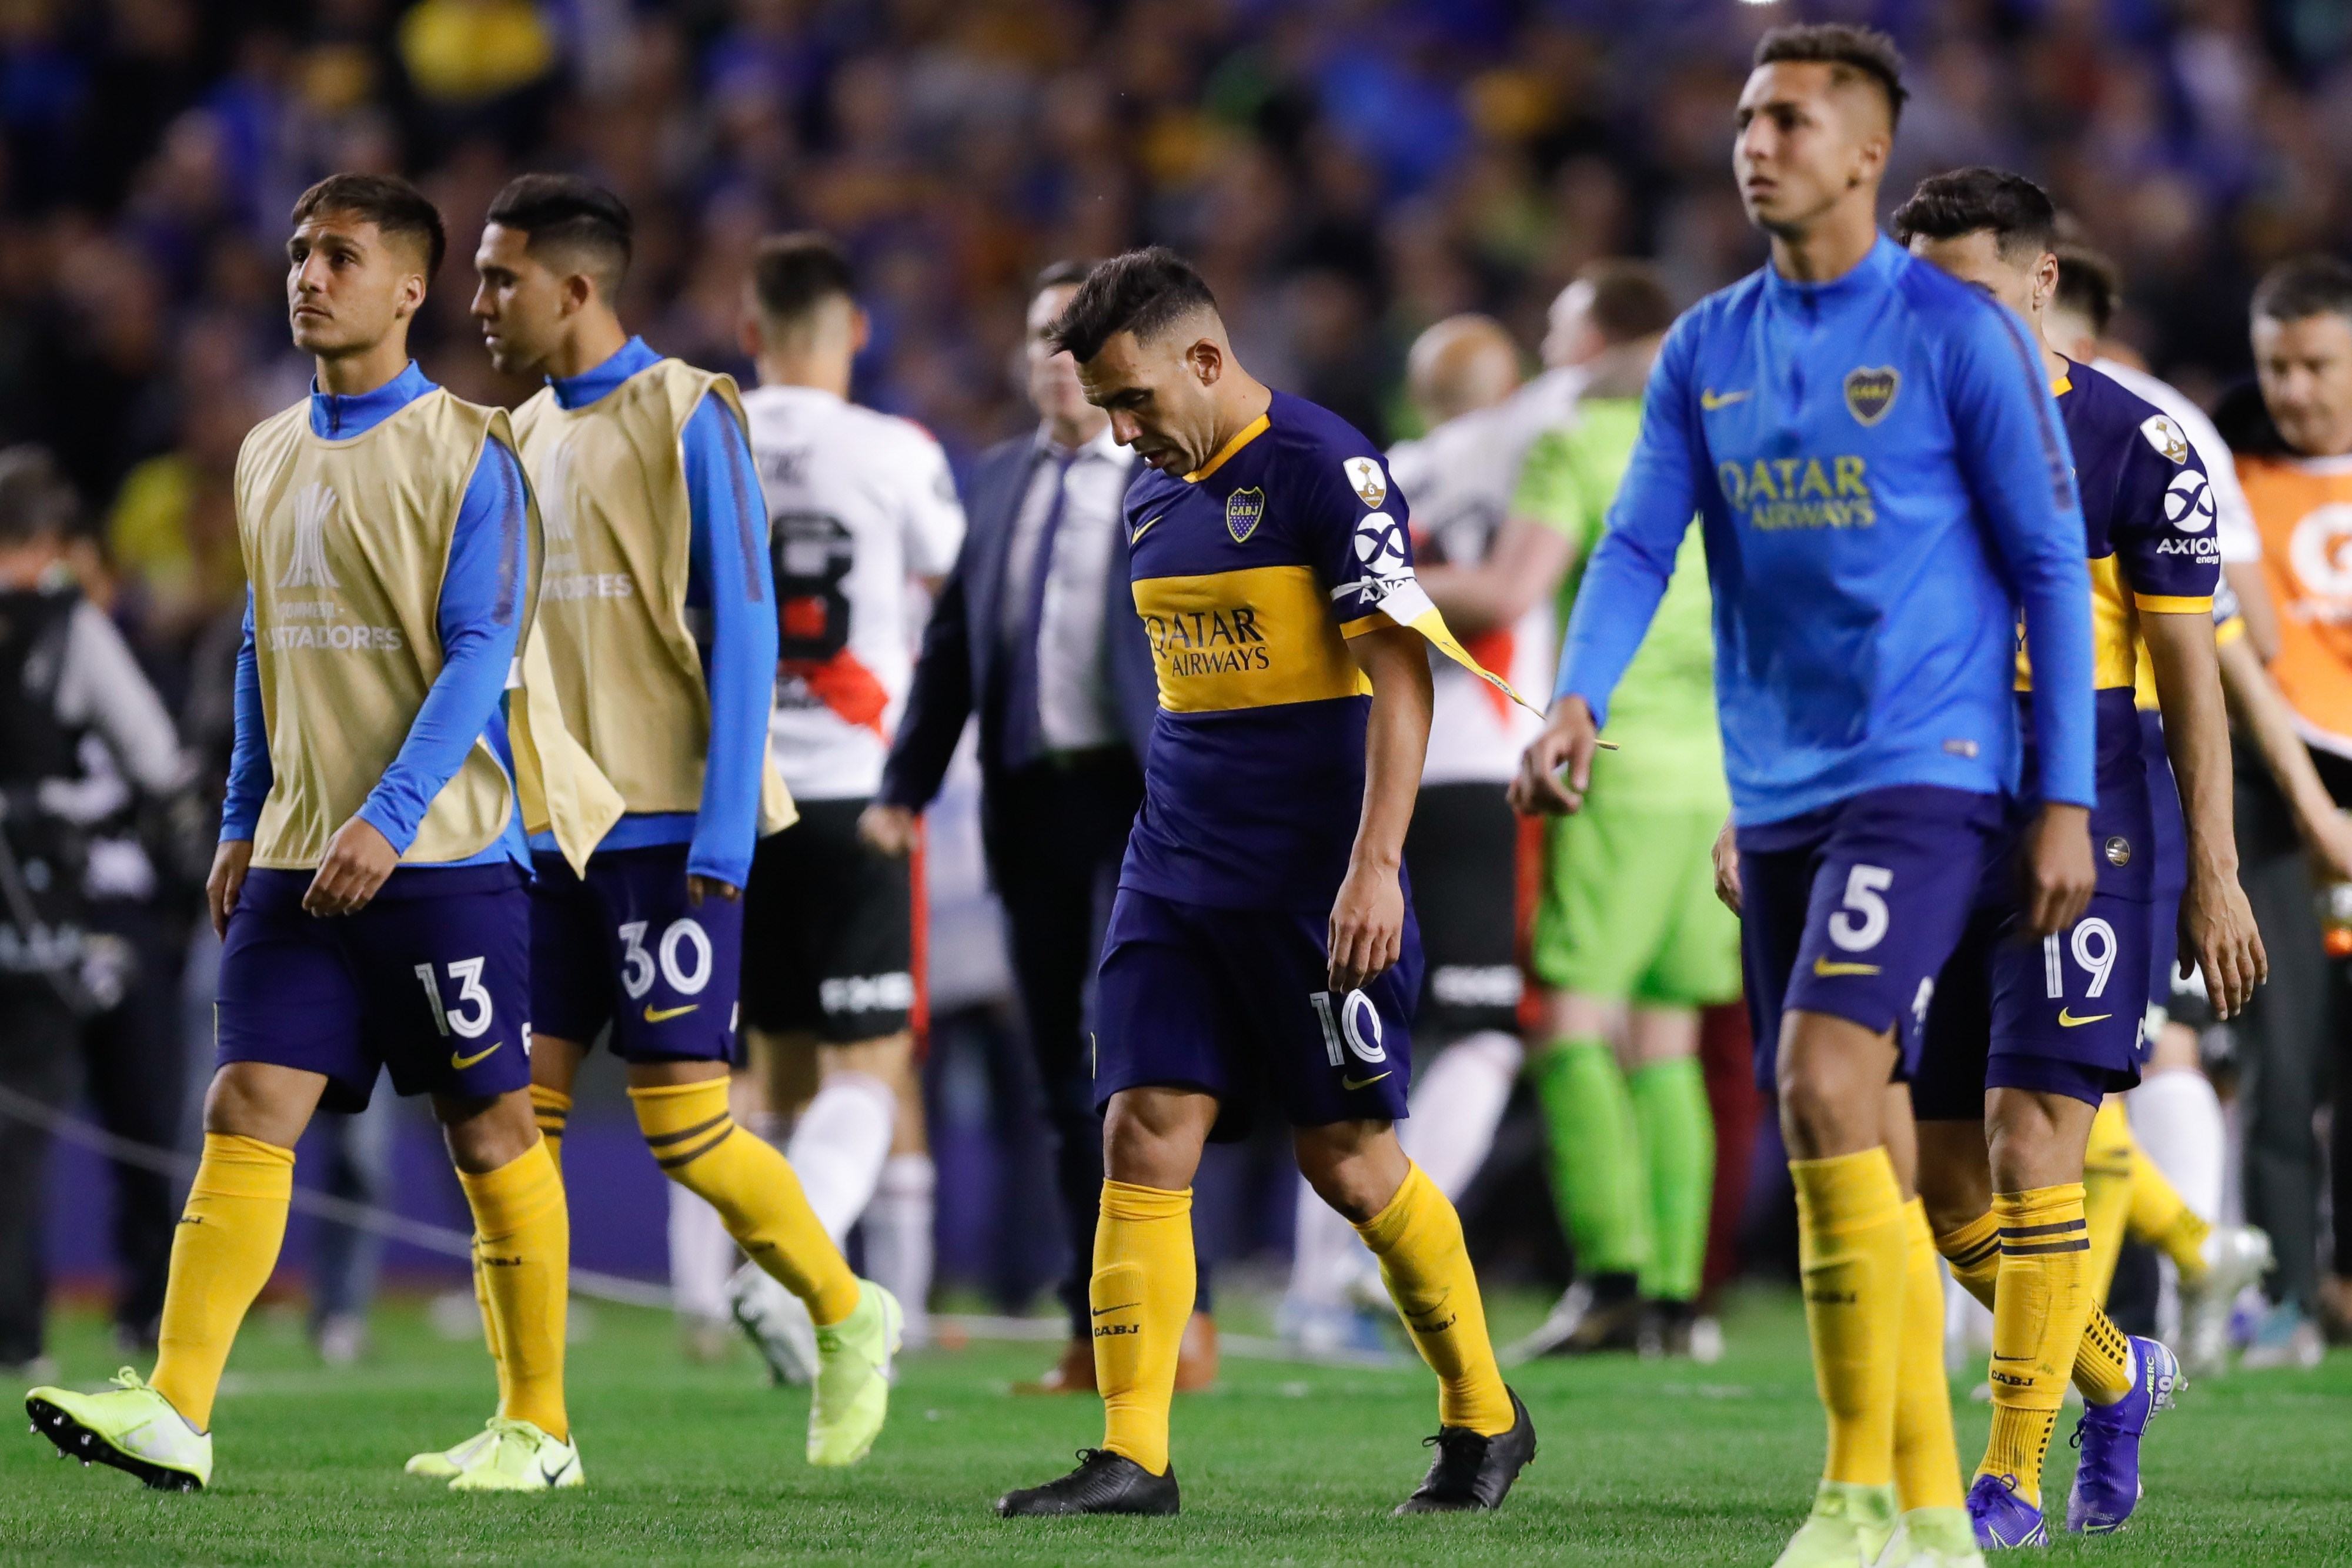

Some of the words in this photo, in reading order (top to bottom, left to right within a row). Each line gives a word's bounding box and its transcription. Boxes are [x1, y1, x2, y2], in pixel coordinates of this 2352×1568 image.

[1368, 484, 1375, 495] 6
[1719, 456, 1869, 511] QATAR
[1230, 506, 1258, 516] CABJ
[2156, 537, 2219, 555] AXION
[1147, 609, 1264, 660] QATAR
[1172, 647, 1269, 677] AIRWAYS
[1828, 864, 1893, 952] 5
[618, 918, 712, 999] 30
[2043, 917, 2117, 999] 19
[414, 956, 493, 1038] 13
[1309, 988, 1387, 1066] 10
[1094, 1324, 1140, 1337] CABJ
[1992, 1370, 2034, 1386] CABJ
[2146, 1355, 2156, 1395] MERC
